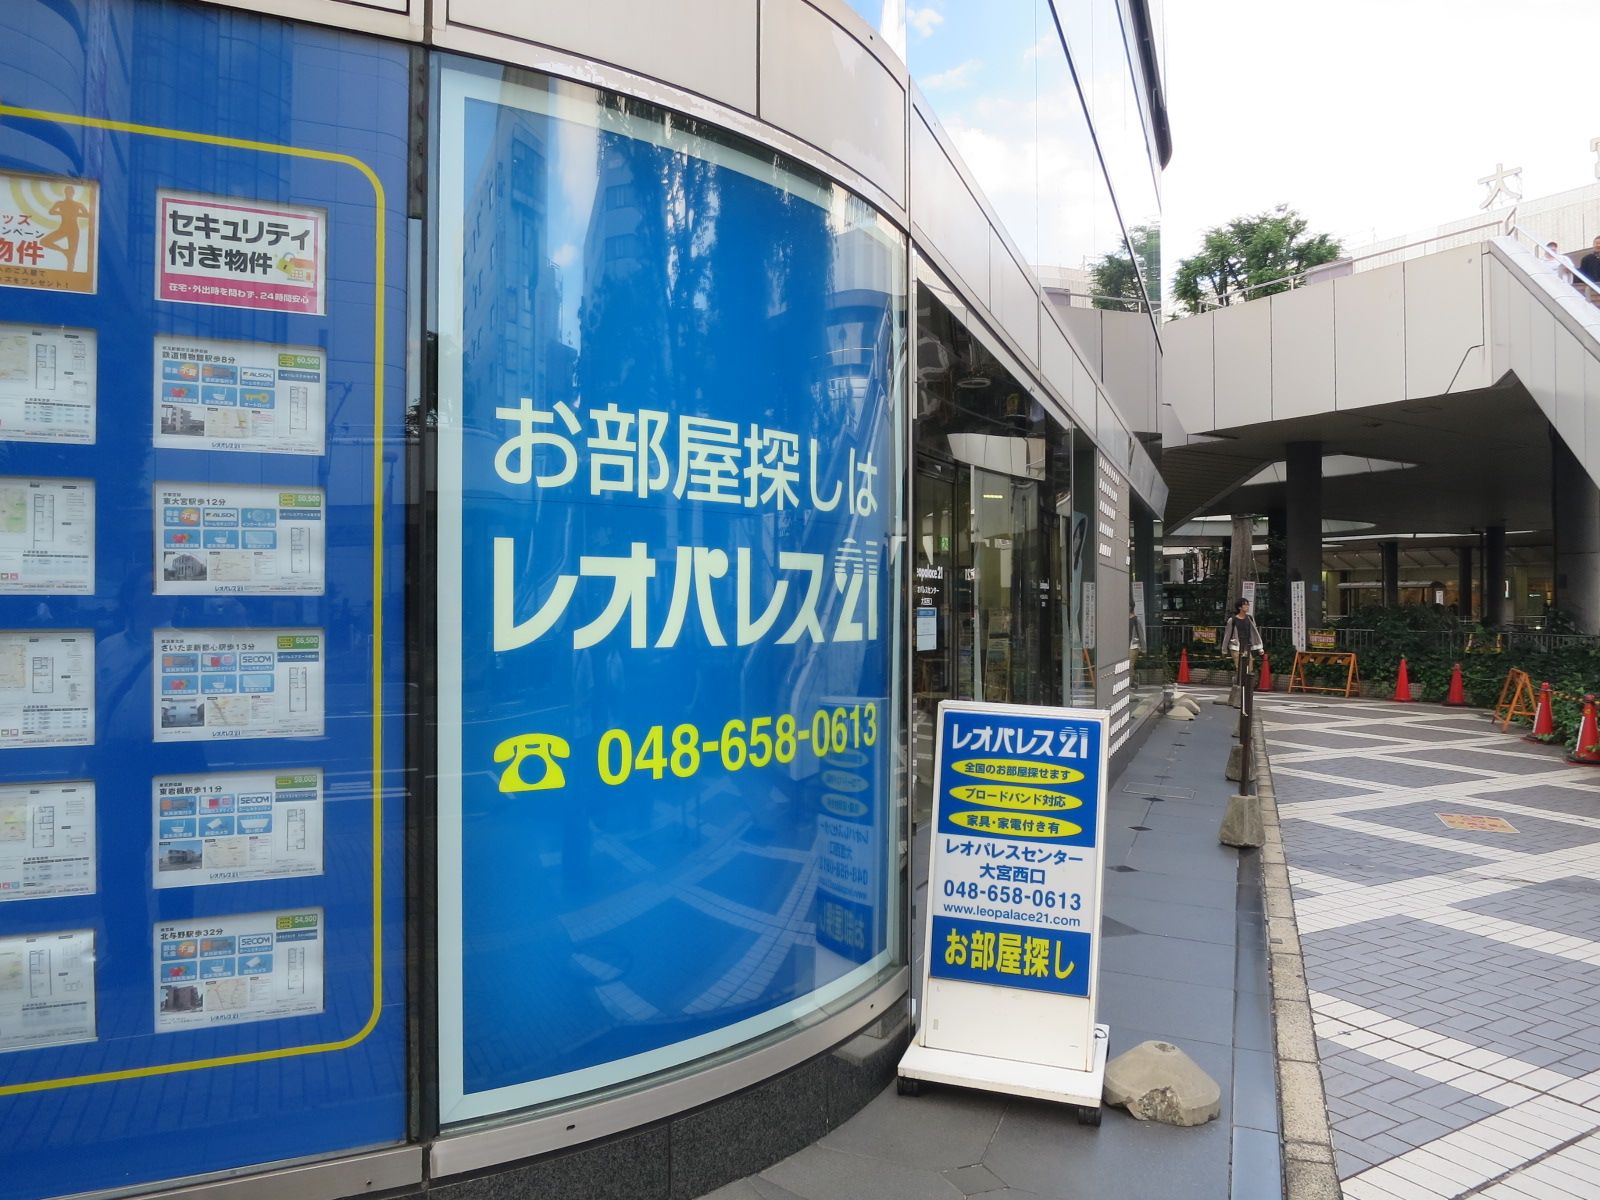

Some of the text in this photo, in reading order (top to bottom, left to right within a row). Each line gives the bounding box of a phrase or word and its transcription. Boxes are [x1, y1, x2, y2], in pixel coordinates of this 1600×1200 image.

[169, 210, 310, 250] セキュリティ
[169, 240, 272, 275] 付き物件
[494, 397, 878, 517] お部屋探しは
[163, 498, 226, 506] 東大宮駅歩12分
[493, 537, 878, 652] レオパレス21
[161, 643, 255, 652] さいたま新都心駅歩13分
[242, 655, 271, 664] SECOM
[597, 702, 878, 786] 048-658-0613
[952, 723, 1089, 759] レオパレス21
[964, 761, 1071, 780] 全国のお部屋探せます
[240, 795, 270, 804] SECOM
[965, 788, 1066, 808] ブロードバンド対応
[966, 814, 1060, 834] 家具・家電付き有
[945, 839, 1083, 865] レオパレスセンター
[979, 863, 1046, 885] 大宮西口
[943, 879, 1081, 911] 048-658-0613
[943, 903, 1081, 927] www.leopalace21.com
[160, 928, 224, 940] 北与野駅歩32分
[241, 936, 270, 946] SECOM
[944, 928, 1075, 980] お部屋探し
